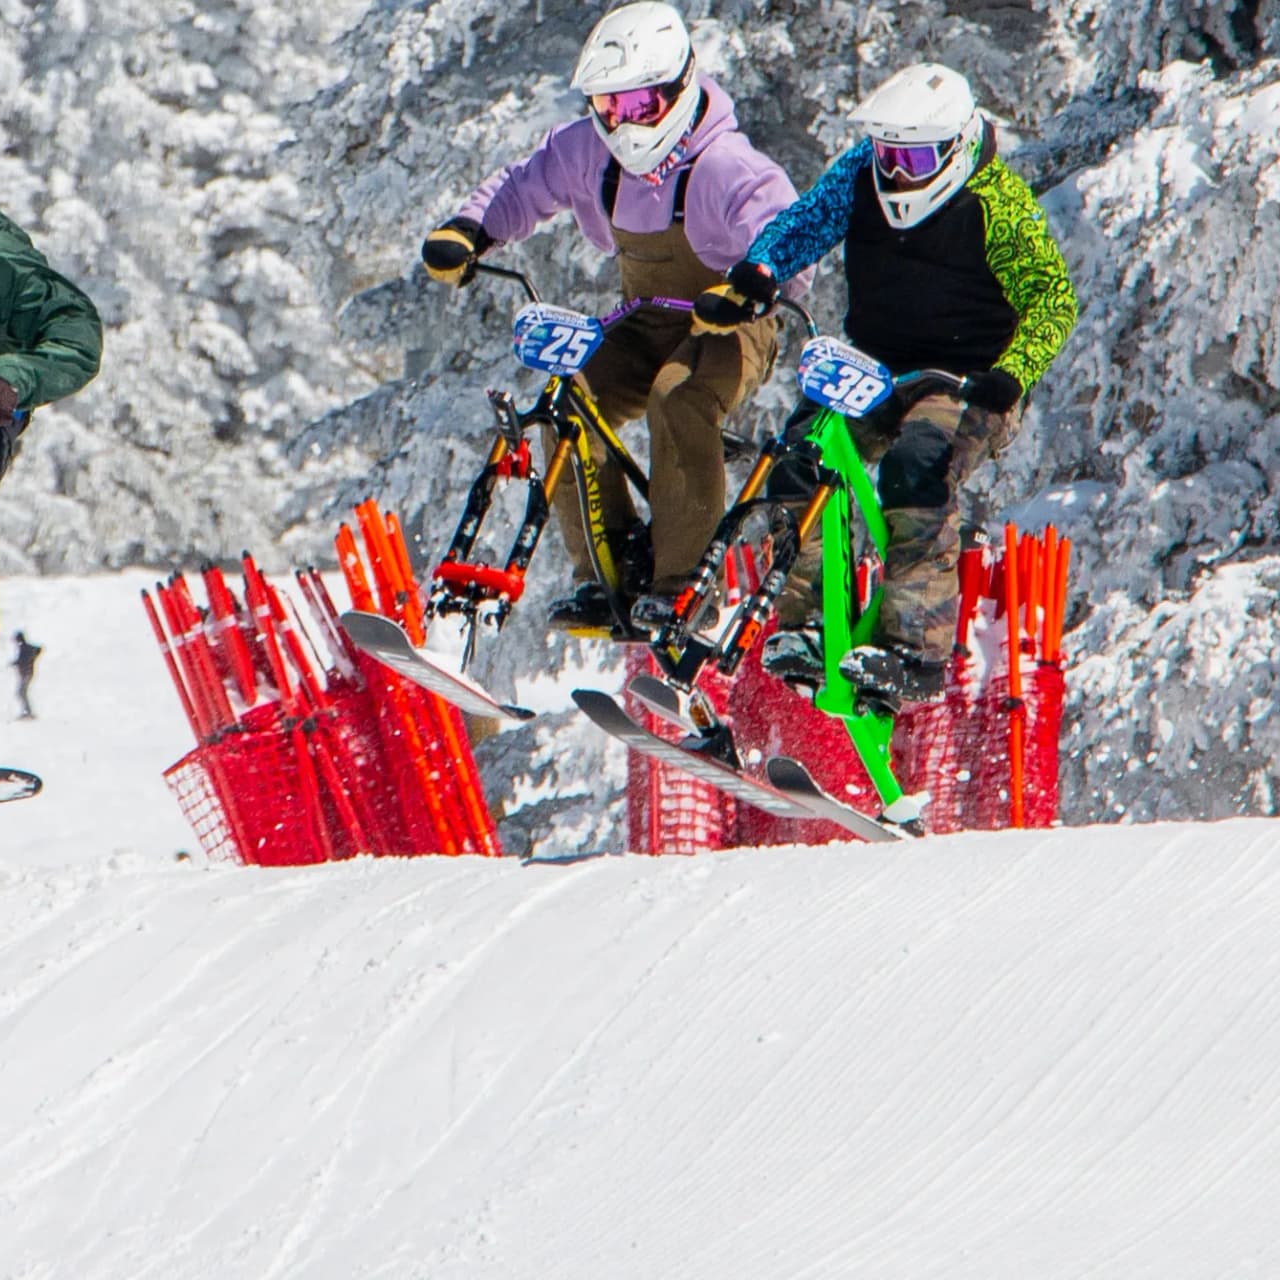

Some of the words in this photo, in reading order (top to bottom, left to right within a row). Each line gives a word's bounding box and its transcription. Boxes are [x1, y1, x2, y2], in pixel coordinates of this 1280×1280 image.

[538, 325, 597, 368] 25
[822, 365, 886, 412] 38
[583, 458, 608, 547] SKIBYK
